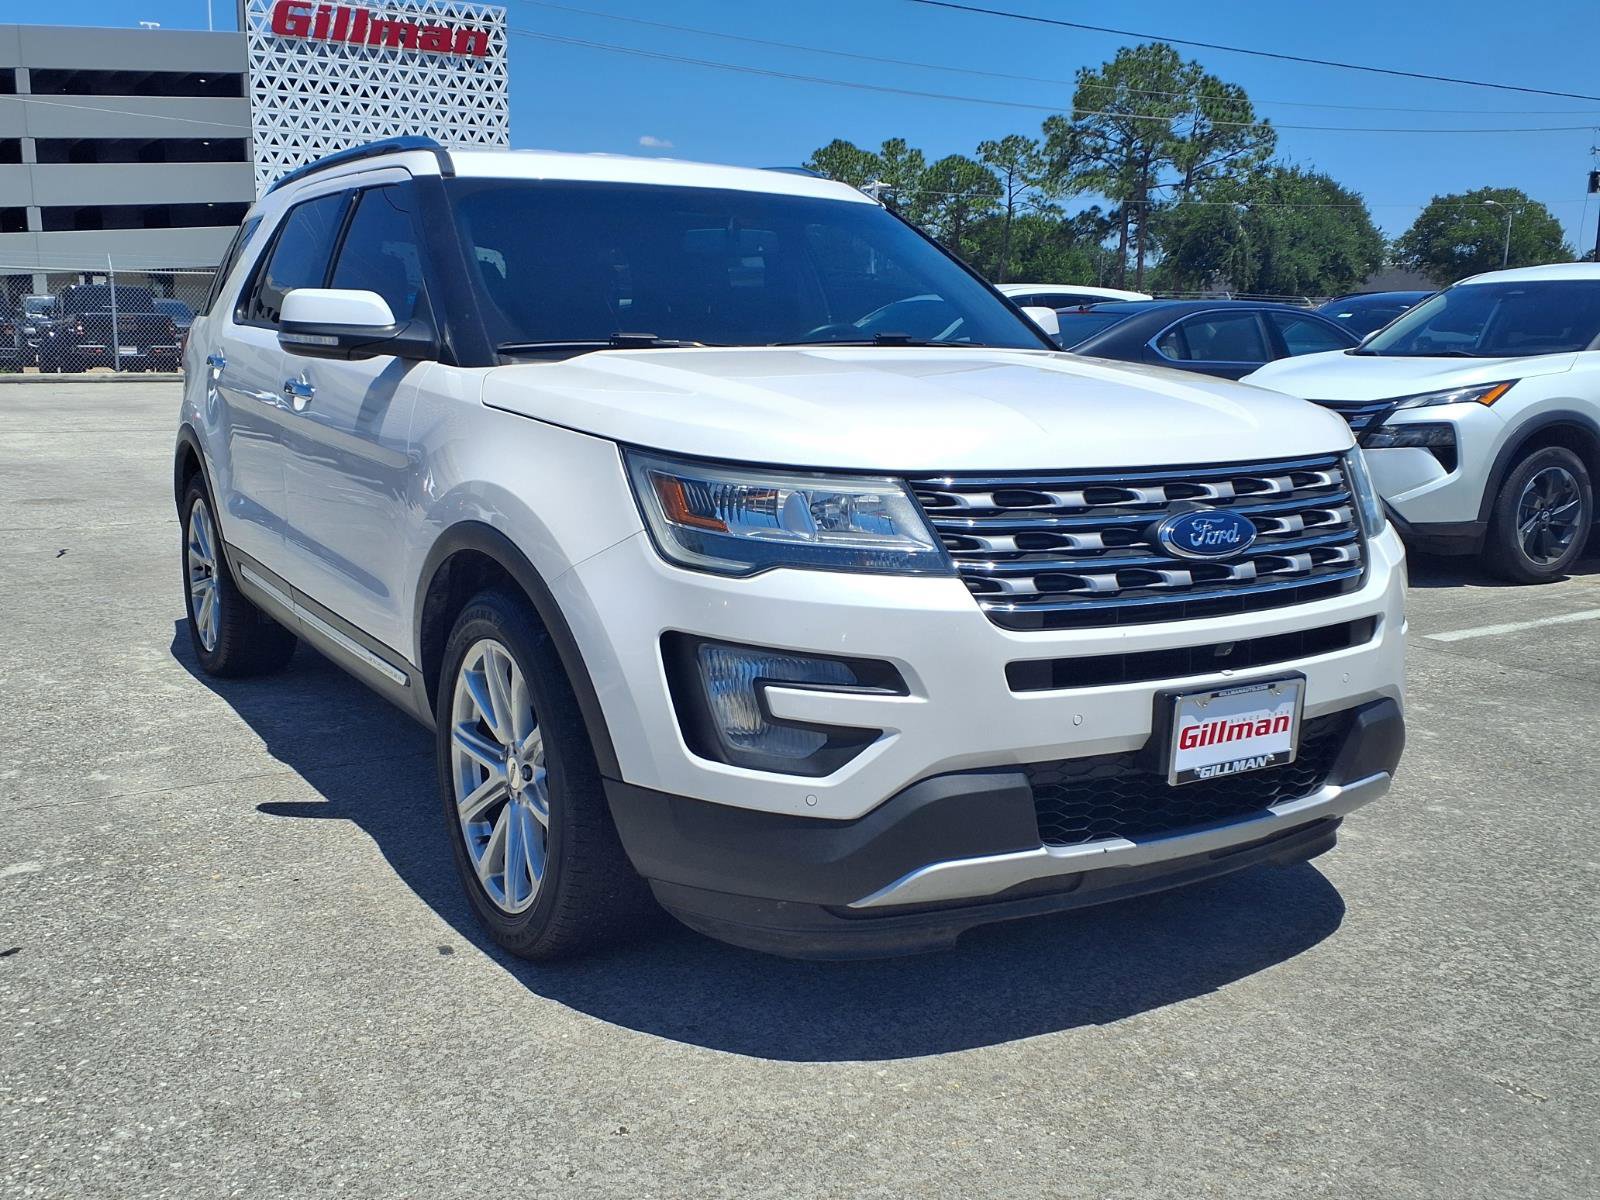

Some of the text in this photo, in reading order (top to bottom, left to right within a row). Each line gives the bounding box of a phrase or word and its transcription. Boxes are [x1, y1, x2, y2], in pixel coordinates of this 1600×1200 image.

[271, 0, 489, 59] Gillman
[1190, 518, 1240, 546] Ford
[1179, 715, 1290, 750] Gillman
[1200, 755, 1268, 778] GILLMAN
